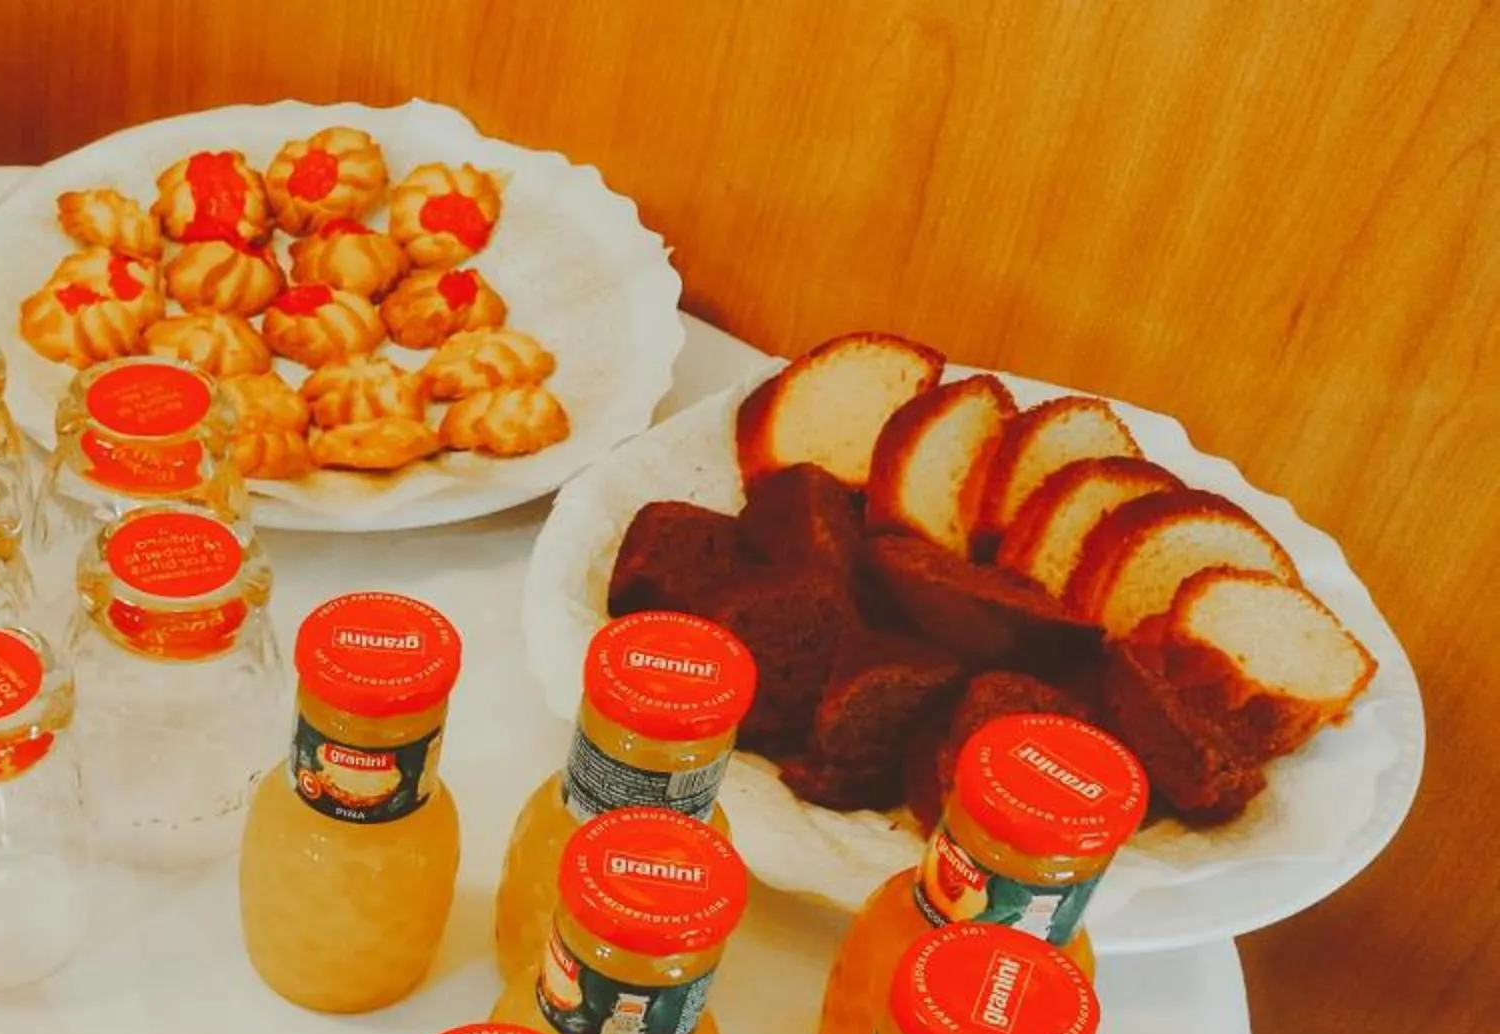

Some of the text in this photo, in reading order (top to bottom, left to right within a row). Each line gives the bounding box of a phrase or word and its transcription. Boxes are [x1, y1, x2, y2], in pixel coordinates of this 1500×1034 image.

[337, 632, 419, 649] granini
[629, 651, 717, 677] granini
[331, 750, 387, 767] granini
[1019, 747, 1103, 799] granini
[611, 857, 705, 882] granini
[983, 957, 1020, 1027] granini
